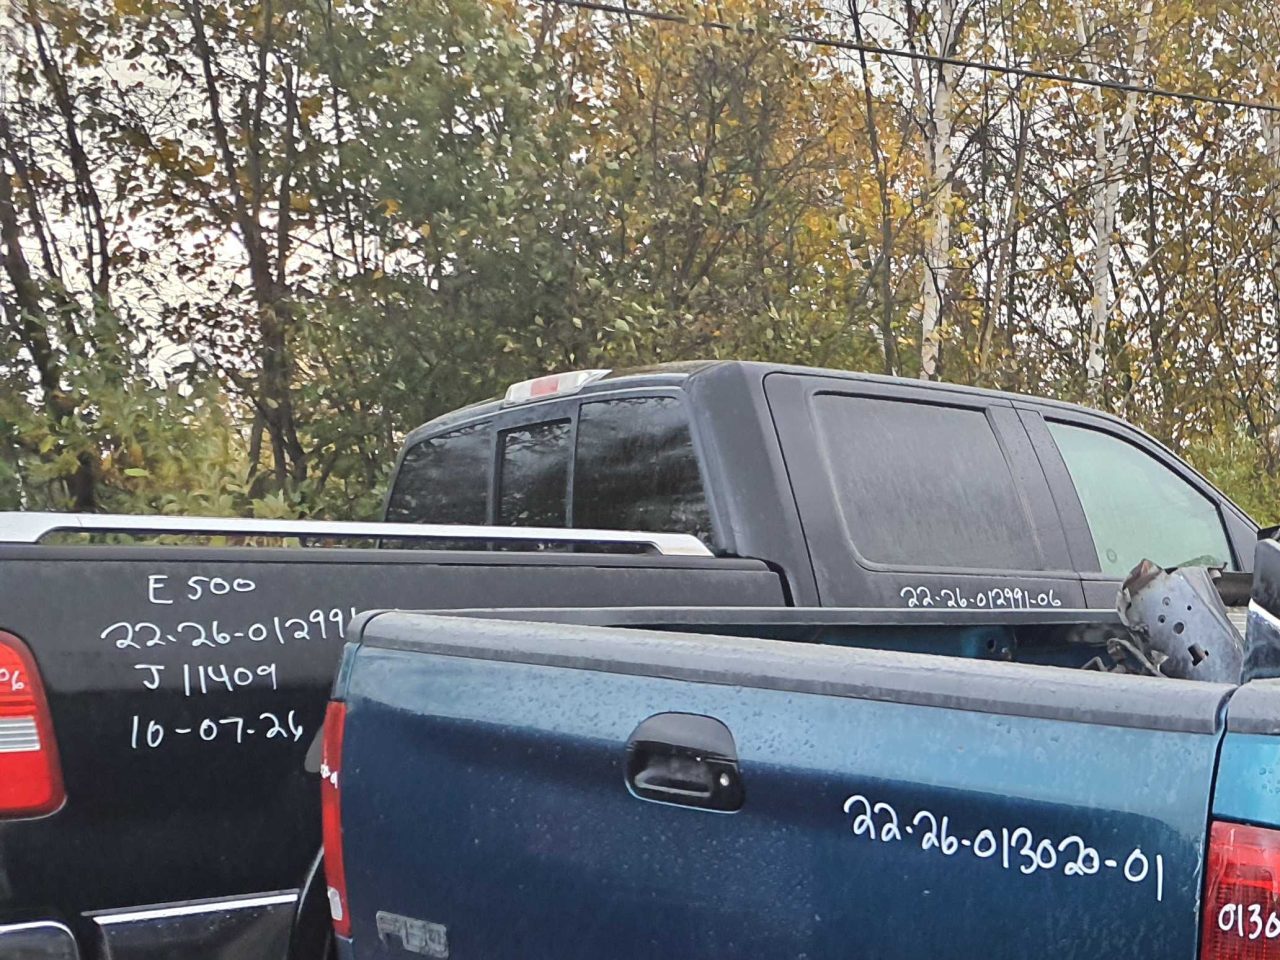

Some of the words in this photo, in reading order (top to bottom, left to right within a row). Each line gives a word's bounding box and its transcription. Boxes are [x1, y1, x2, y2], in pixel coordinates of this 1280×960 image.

[148, 574, 174, 605] E
[187, 575, 256, 601] 500
[134, 663, 165, 690] J
[183, 663, 277, 697] 11409
[131, 709, 304, 749] 10-07-26
